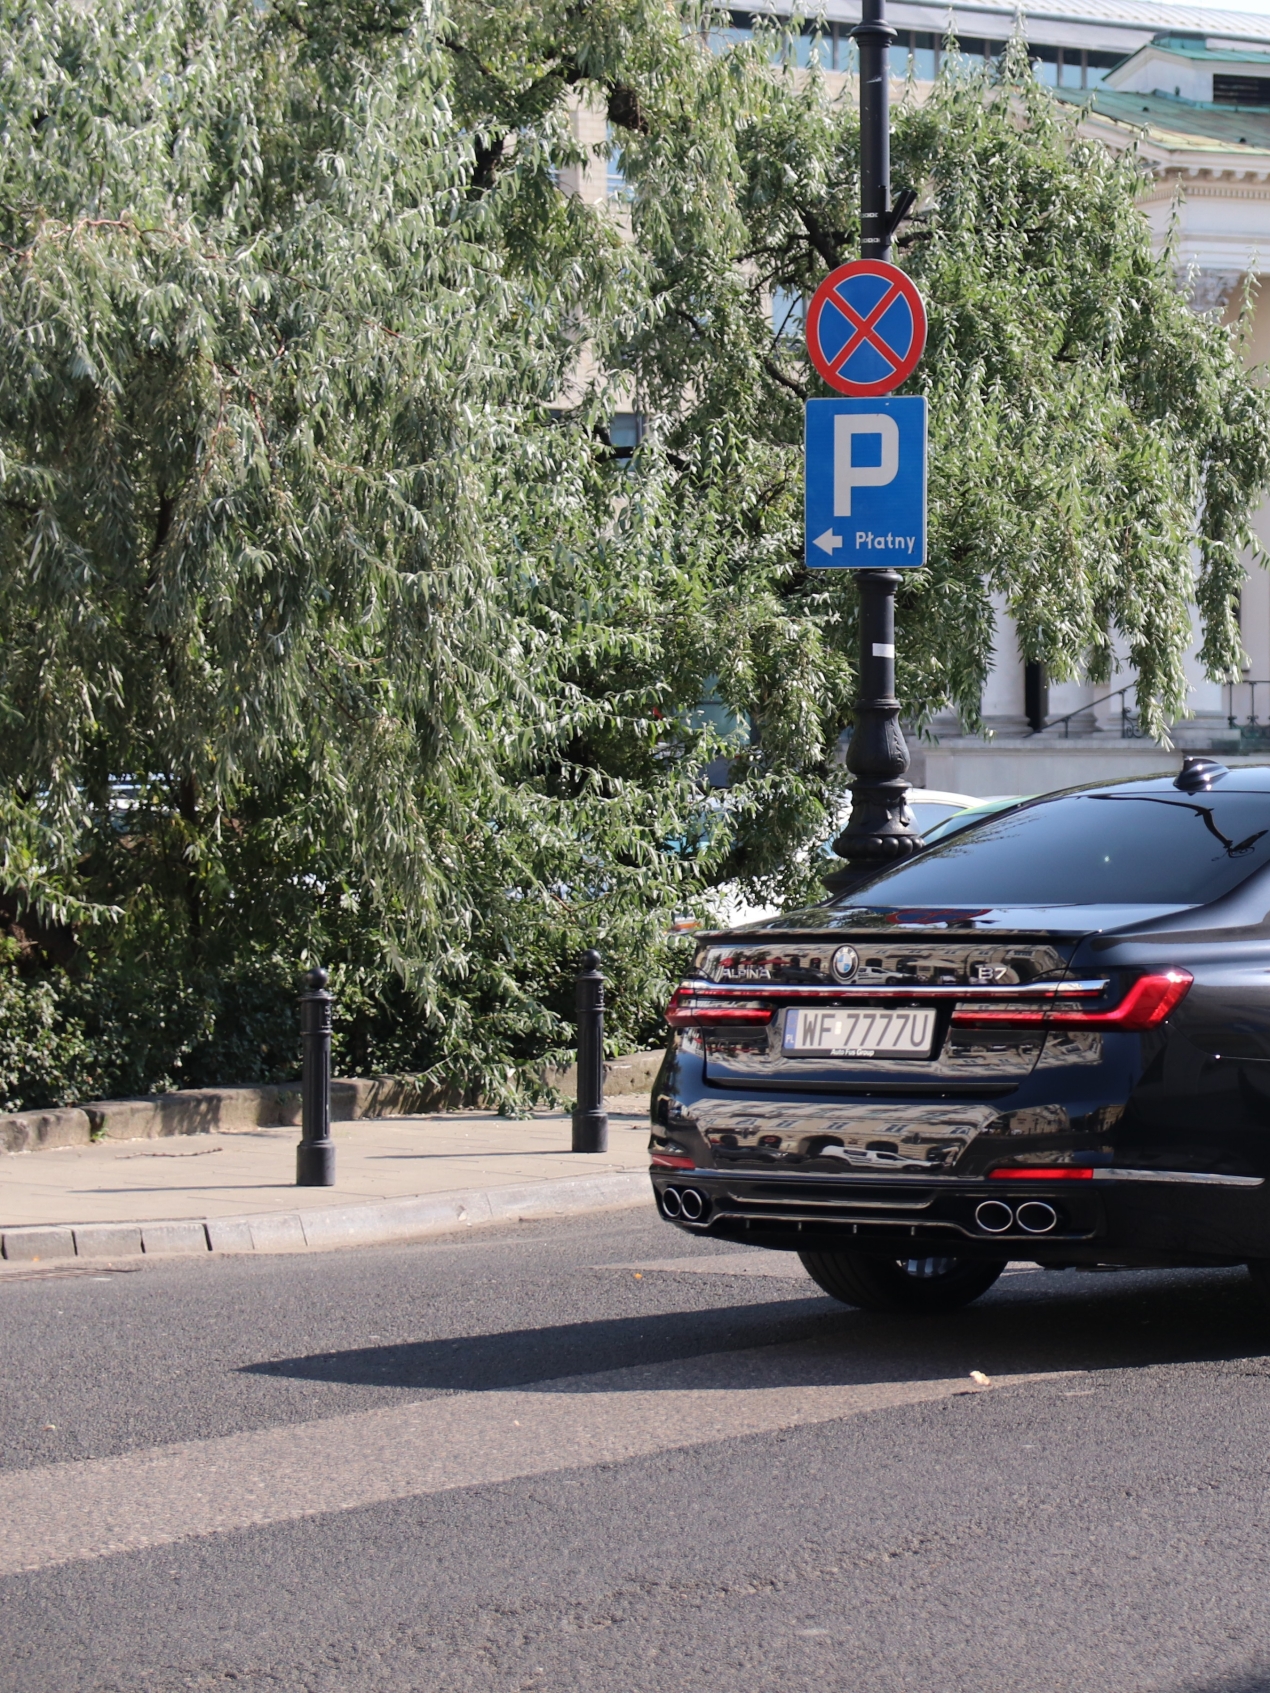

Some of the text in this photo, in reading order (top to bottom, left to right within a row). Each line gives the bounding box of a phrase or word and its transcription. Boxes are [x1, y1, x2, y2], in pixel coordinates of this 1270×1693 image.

[834, 413, 899, 517] P
[855, 531, 915, 555] Płatny
[722, 966, 771, 979] ALPINA
[978, 967, 1007, 980] B7
[801, 1013, 929, 1047] WF 7777U
[785, 1034, 795, 1044] PL
[830, 1048, 875, 1058] Auto Fus Group
